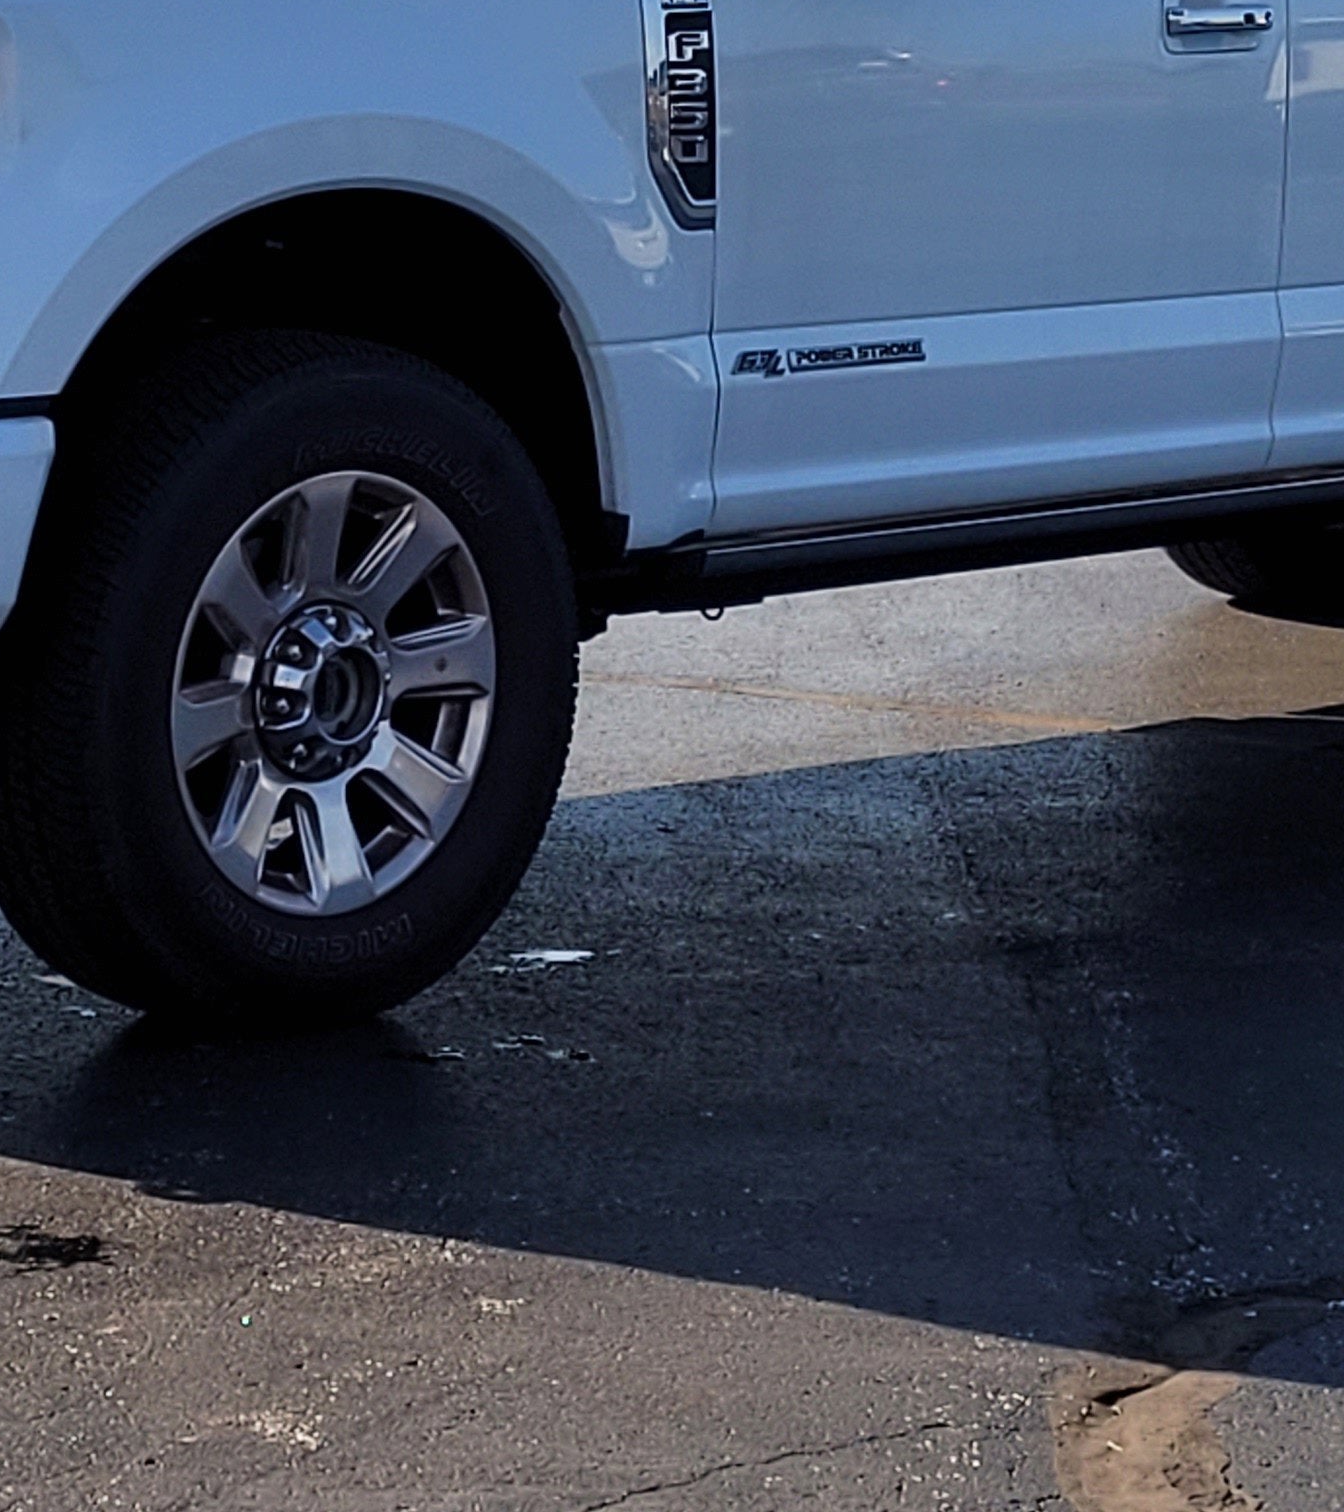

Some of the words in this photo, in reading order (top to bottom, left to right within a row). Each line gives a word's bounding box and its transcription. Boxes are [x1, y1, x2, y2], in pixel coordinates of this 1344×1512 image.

[667, 30, 709, 163] F350
[796, 346, 854, 365] POWER
[857, 339, 923, 359] STROKE
[293, 425, 497, 518] MICHELIN
